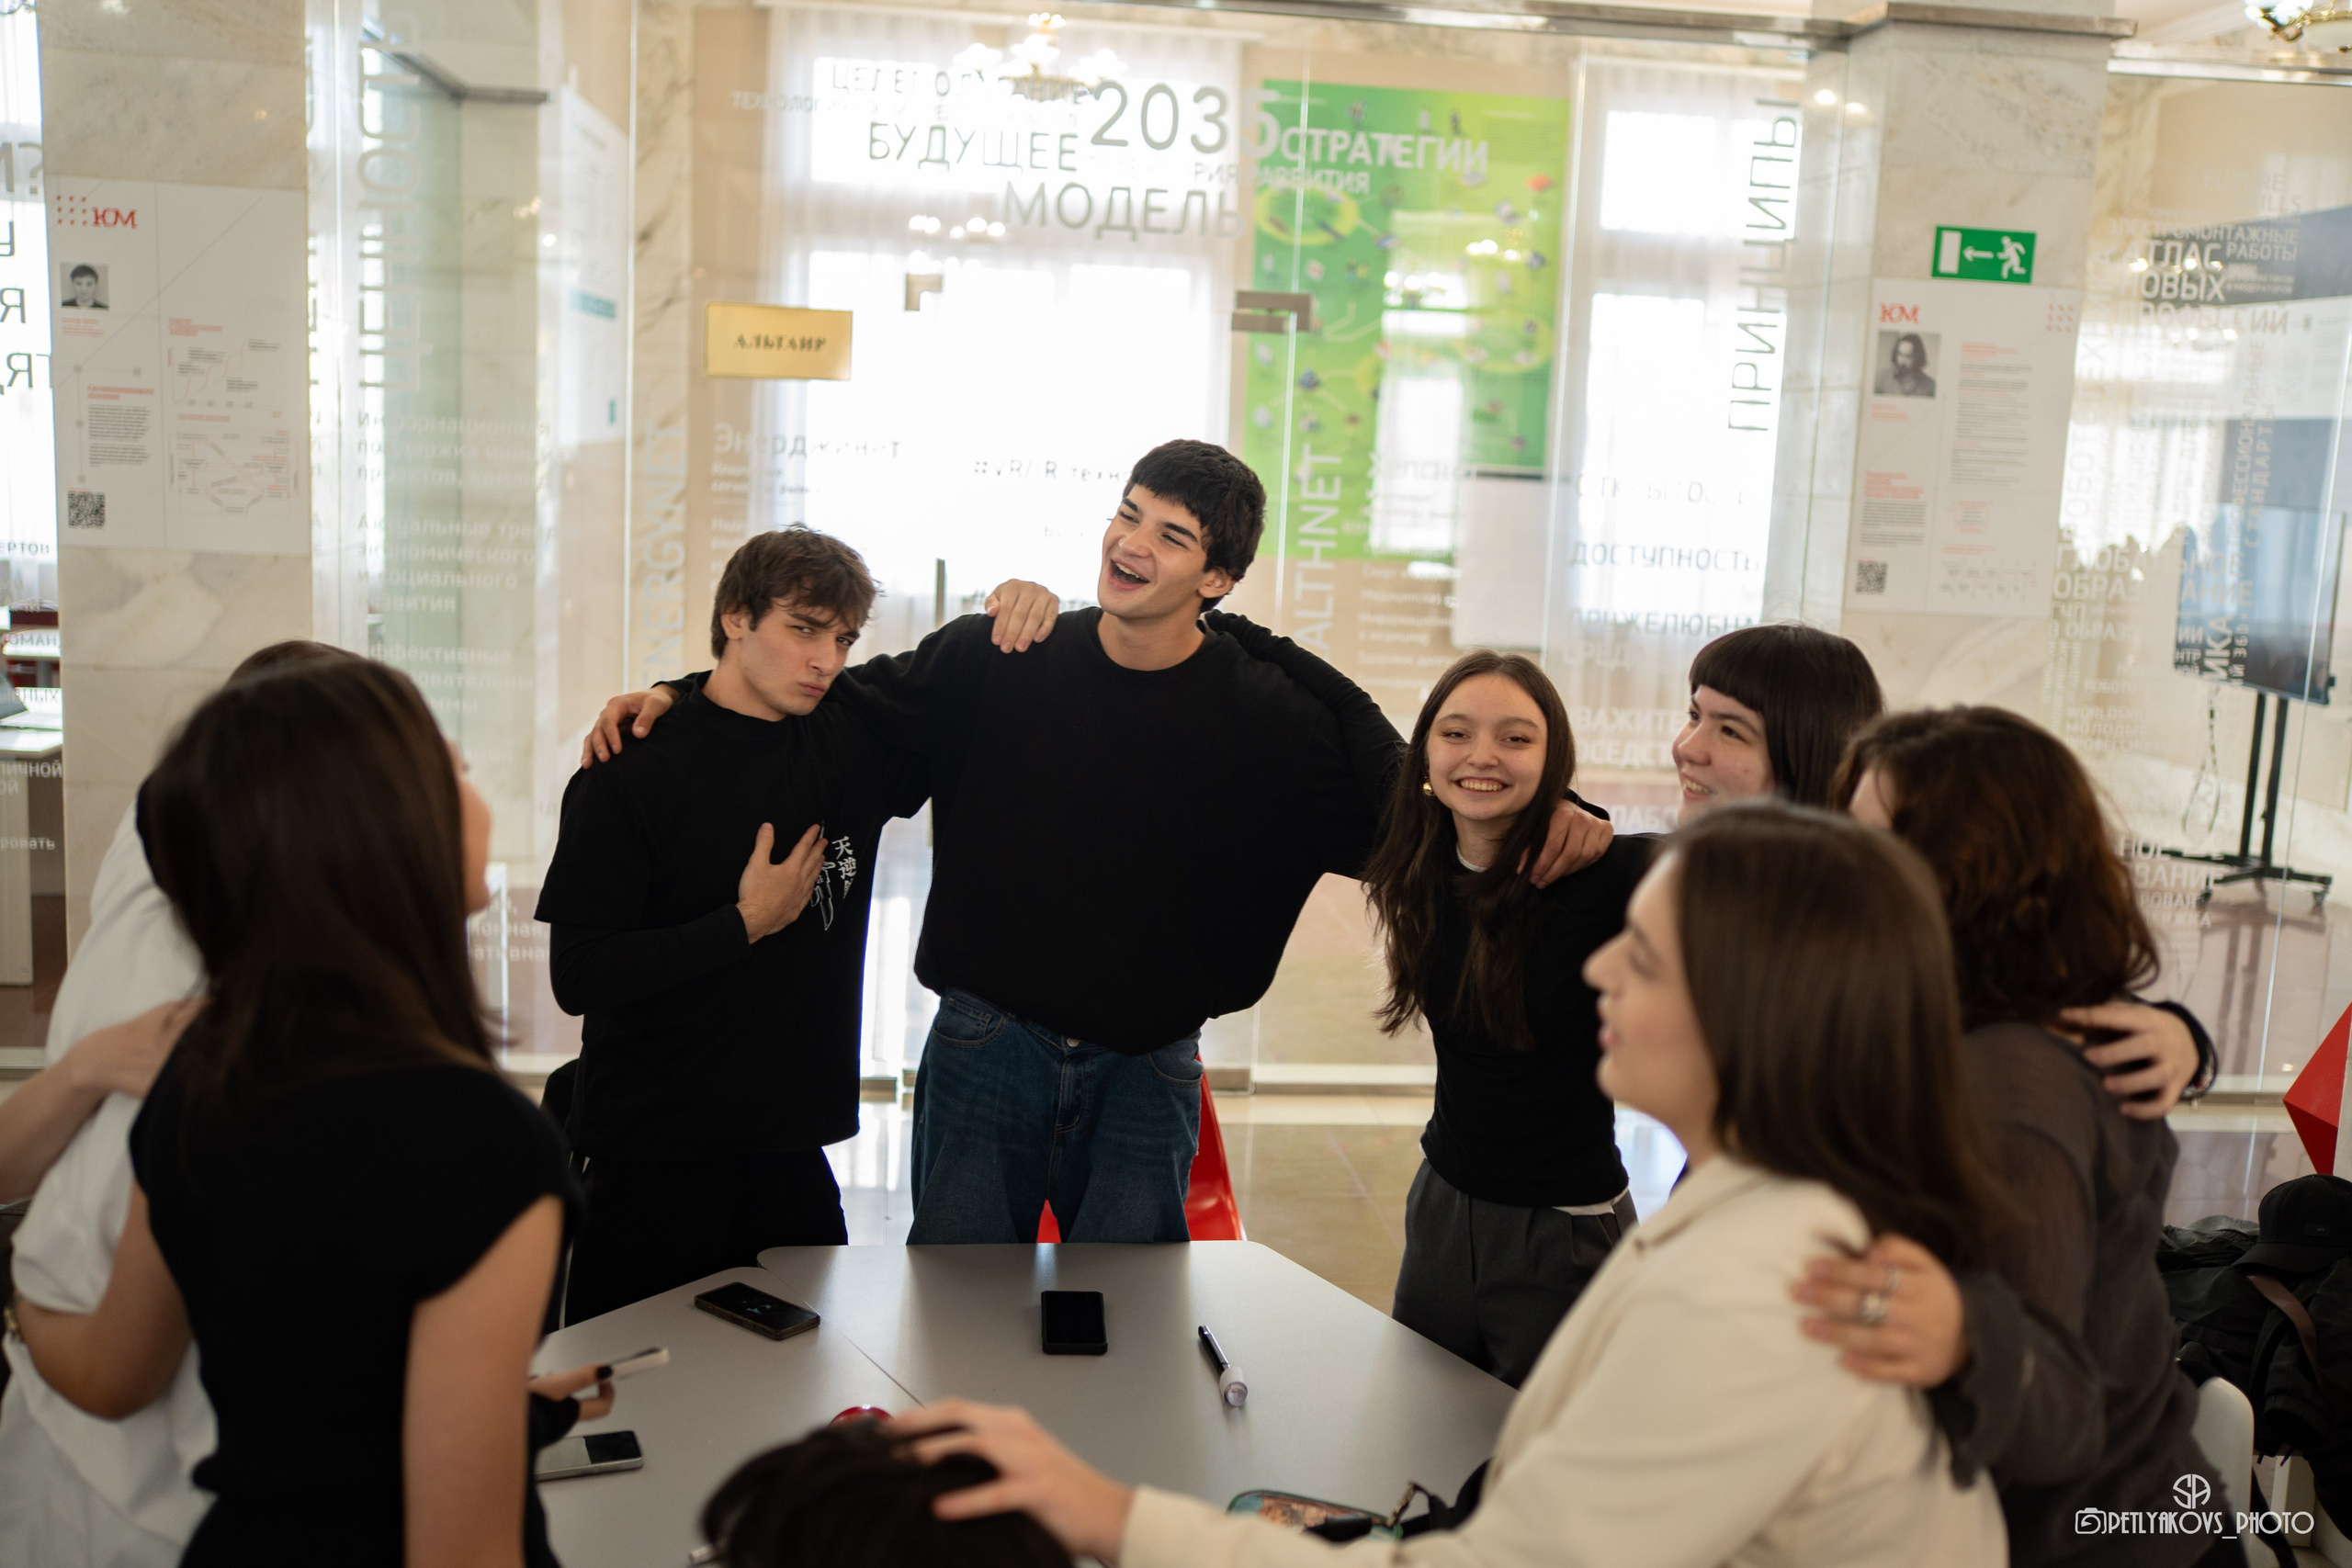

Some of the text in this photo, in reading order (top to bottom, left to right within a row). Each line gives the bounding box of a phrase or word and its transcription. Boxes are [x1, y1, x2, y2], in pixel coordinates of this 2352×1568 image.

[1091, 79, 1280, 159] 2035
[869, 120, 1079, 175] БУДУЩЕЕ
[1282, 127, 1489, 174] СТРАТЕГИИ
[1005, 180, 1246, 242] МОДЕЛЬ
[2107, 217, 2300, 244] ЭЛЕКТРОМОНТАЖНЫЕ
[1728, 96, 1803, 432] ПРИНЦИПЫ
[2127, 240, 2222, 271] АТЛАС
[2226, 242, 2298, 261] РАБОТЫ
[2120, 271, 2227, 302] НОВЫХ
[734, 333, 826, 352] АЛЬТАИР
[2244, 402, 2275, 548] СТАНДАРТЫ
[1293, 443, 1342, 661] ALTHNET
[1568, 540, 1759, 572] ДОСТУПНОСТЬ
[2053, 571, 2254, 607] ОБРАЗОАНИЕ
[368, 643, 512, 664] ффективные
